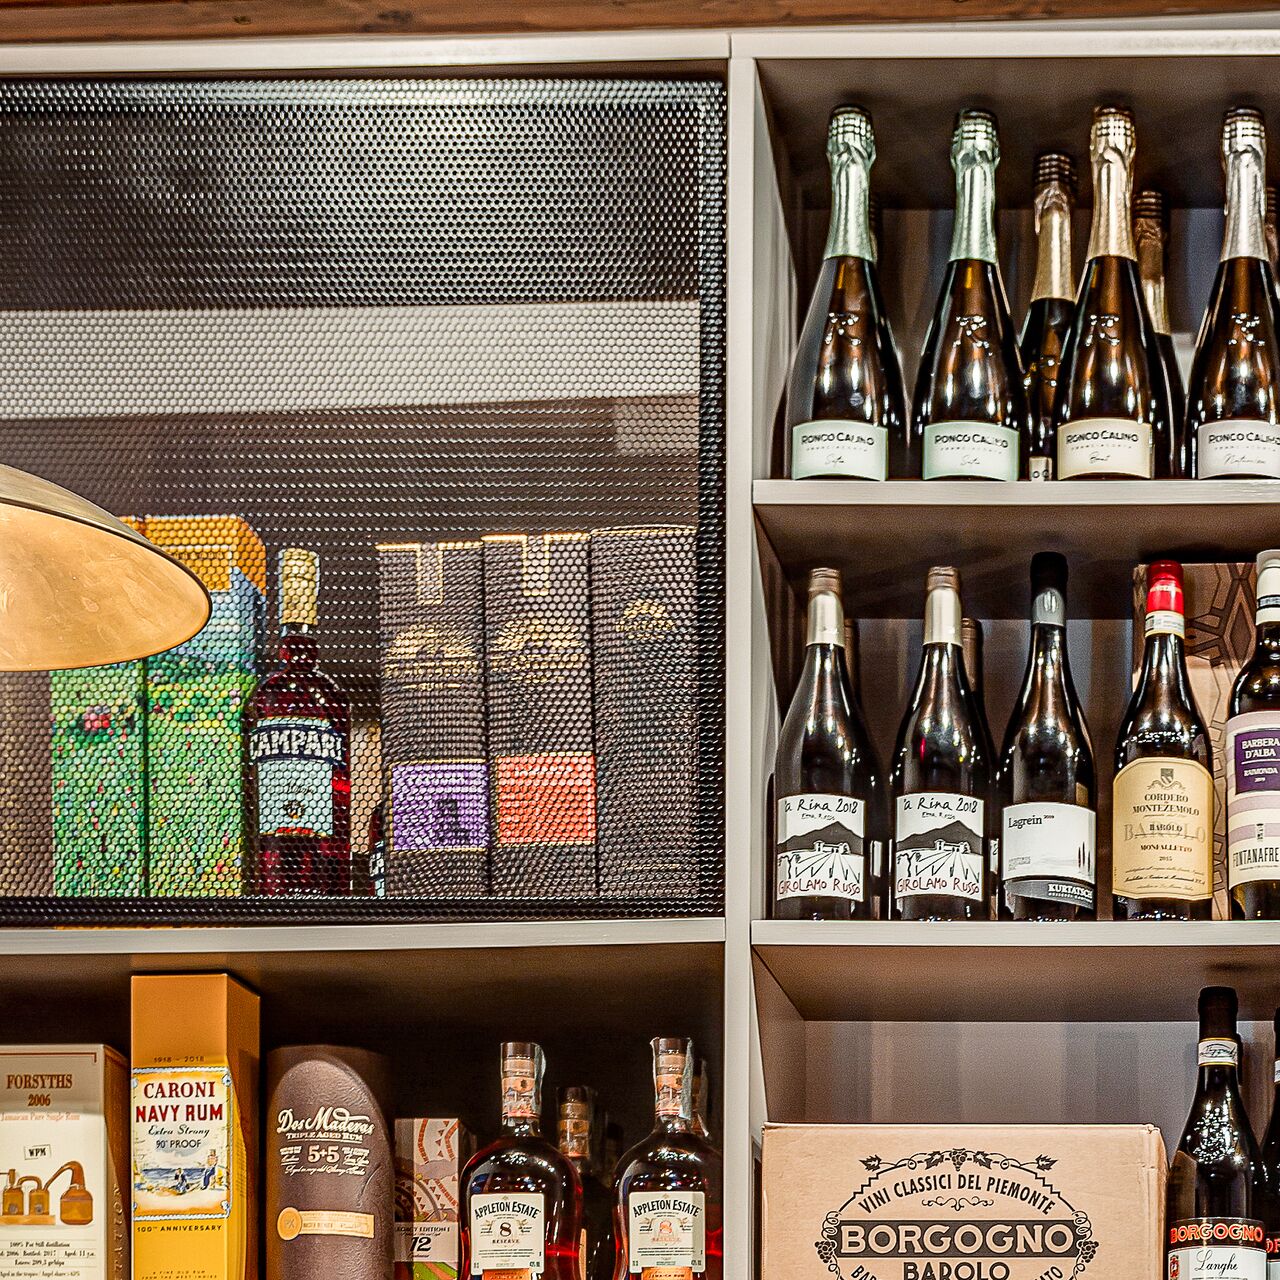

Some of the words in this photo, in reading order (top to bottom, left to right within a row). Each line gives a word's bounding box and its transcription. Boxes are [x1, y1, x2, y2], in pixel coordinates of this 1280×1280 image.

[249, 729, 347, 763] CAMPARI
[1242, 738, 1280, 749] BARBERA
[1245, 748, 1276, 758] D'ALBA
[797, 799, 829, 812] Rina
[836, 799, 858, 813] 2018
[917, 796, 952, 811] Rina
[956, 798, 978, 813] 2018
[1144, 794, 1188, 803] CORDERO
[1132, 804, 1199, 816] MONTEZEMOLO
[1008, 815, 1042, 828] Lagrein
[778, 878, 827, 893] GIROLAMO
[832, 879, 861, 895] RUSSO
[897, 877, 947, 893] GIROLAMO
[953, 878, 980, 895] RUSSO
[6, 1074, 73, 1089] FORSYTHS
[143, 1082, 215, 1099] CARONI
[28, 1094, 51, 1106] 2006
[135, 1105, 179, 1123] NAVY
[185, 1104, 223, 1121] RUM
[277, 1108, 306, 1134] Dos
[305, 1106, 375, 1136] Maderas
[148, 1125, 173, 1136] Extra
[177, 1125, 210, 1137] Strong
[342, 1133, 363, 1141] RUM
[170, 1140, 202, 1148] PROOF
[28, 1148, 47, 1157] WPM
[308, 1145, 340, 1163] 5+5
[858, 1188, 891, 1213] VINI
[893, 1174, 952, 1197] CLASSICI
[958, 1174, 982, 1190] DEL
[986, 1177, 1056, 1215] PIEMONTE
[474, 1203, 511, 1220] APPLETON
[512, 1202, 541, 1219] ESTATE
[840, 1224, 1074, 1254] BORGOGNO
[1170, 1222, 1264, 1244] BORGOGNO
[410, 1237, 432, 1252] 12
[1196, 1250, 1239, 1276] Langhe
